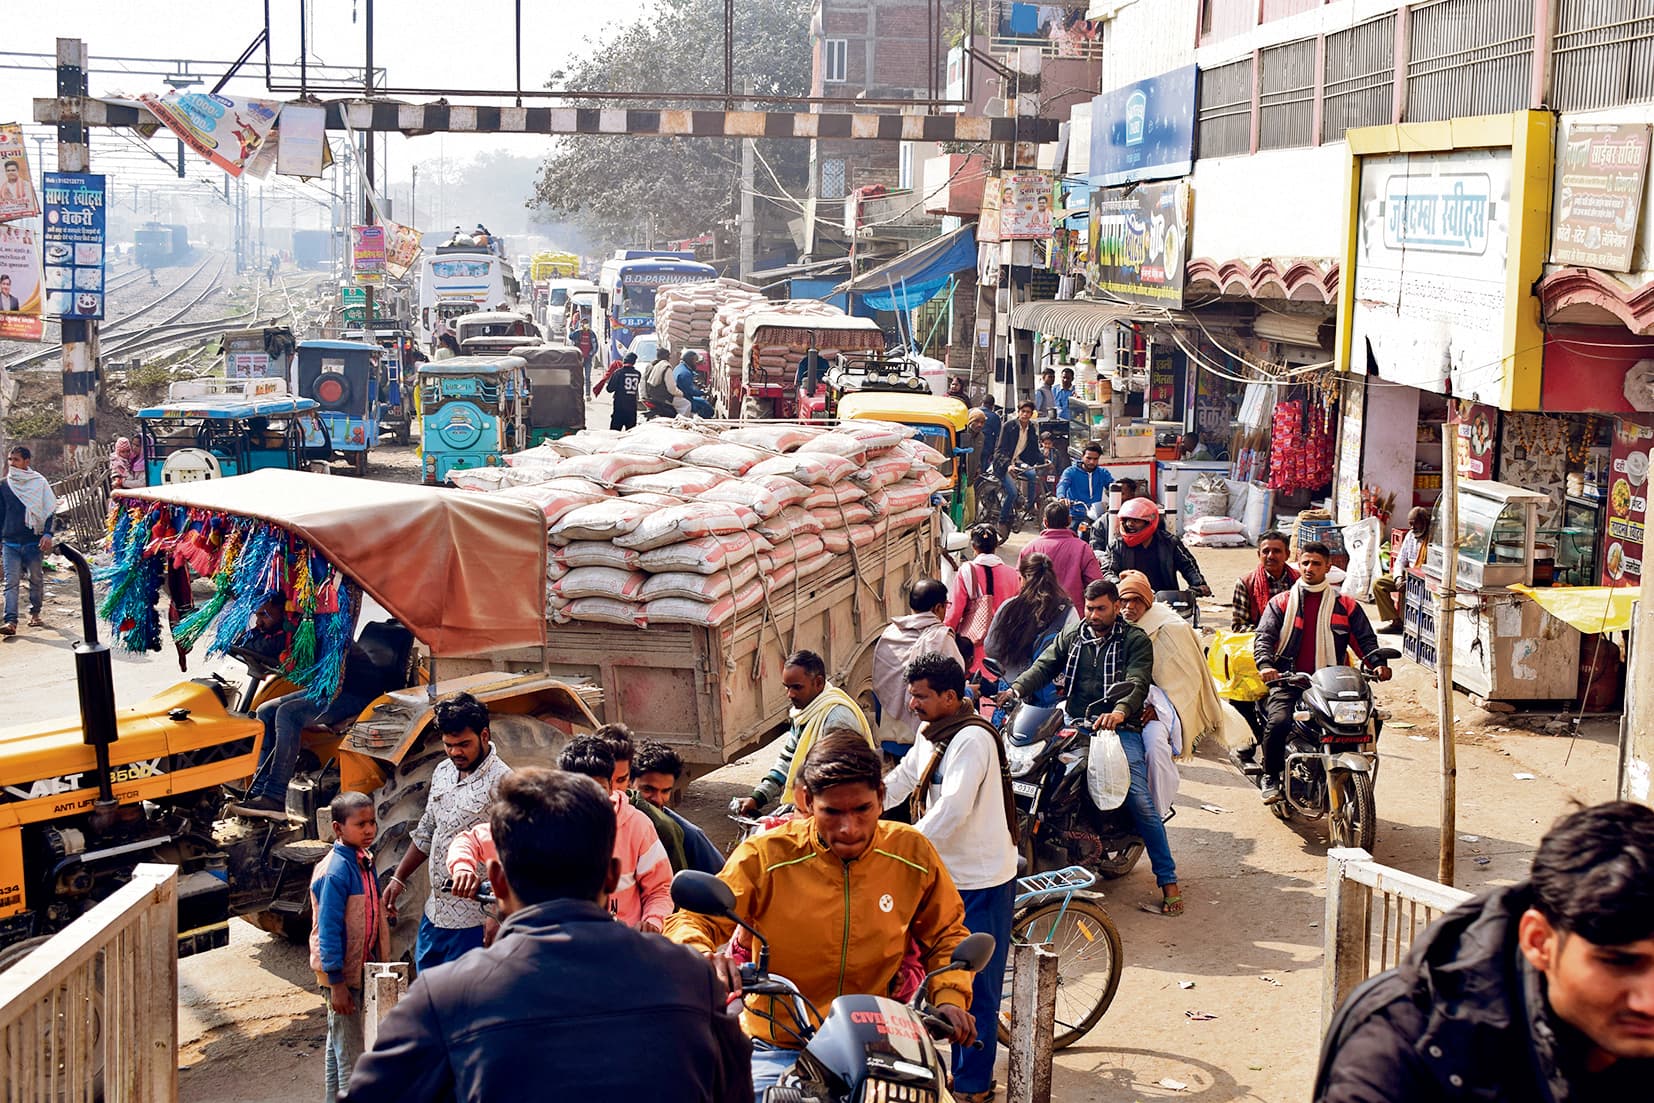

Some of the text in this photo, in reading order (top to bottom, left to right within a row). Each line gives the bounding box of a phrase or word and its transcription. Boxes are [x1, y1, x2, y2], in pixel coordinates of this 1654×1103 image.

[45, 188, 70, 205] सागर
[73, 185, 103, 211] स्वीट्स
[60, 207, 93, 226] बेकरी
[1442, 181, 1487, 248] स्वीट्स
[624, 376, 639, 391] 93
[54, 803, 75, 813] ANTI
[850, 1011, 886, 1024] CIVIL
